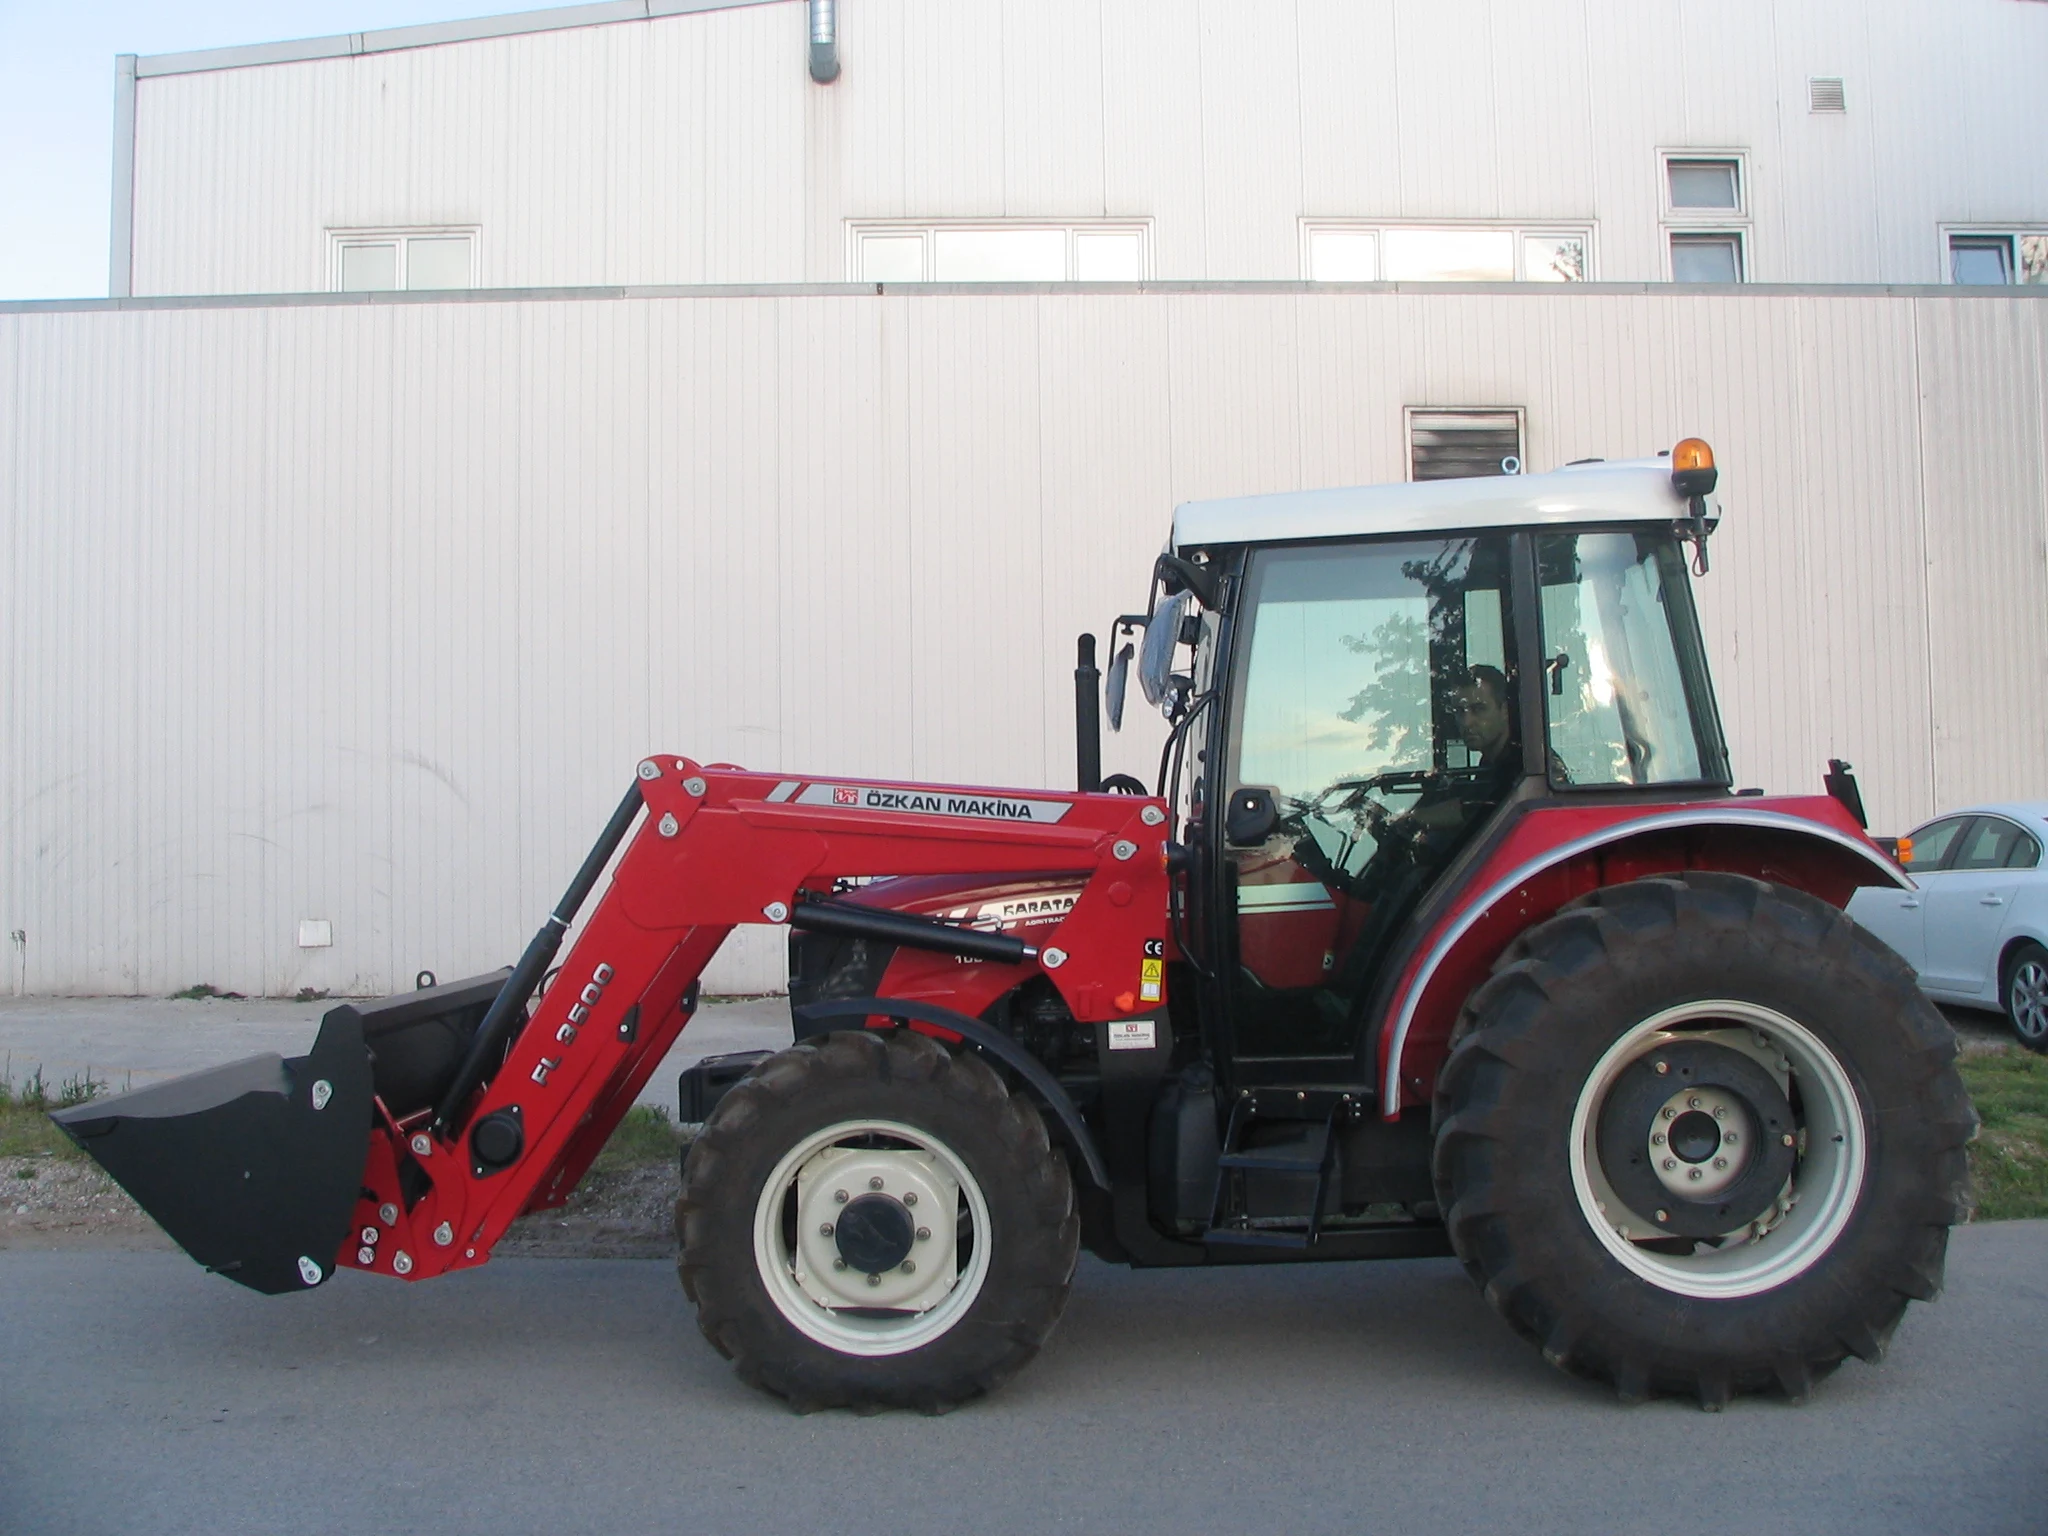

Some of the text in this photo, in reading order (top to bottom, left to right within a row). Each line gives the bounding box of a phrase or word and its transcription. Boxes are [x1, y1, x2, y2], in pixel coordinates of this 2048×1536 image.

[866, 790, 1032, 819] ÖZKAN MAKİNA
[1003, 897, 1075, 916] KARATA
[1144, 941, 1163, 955] CE
[530, 962, 614, 1087] FL 3500
